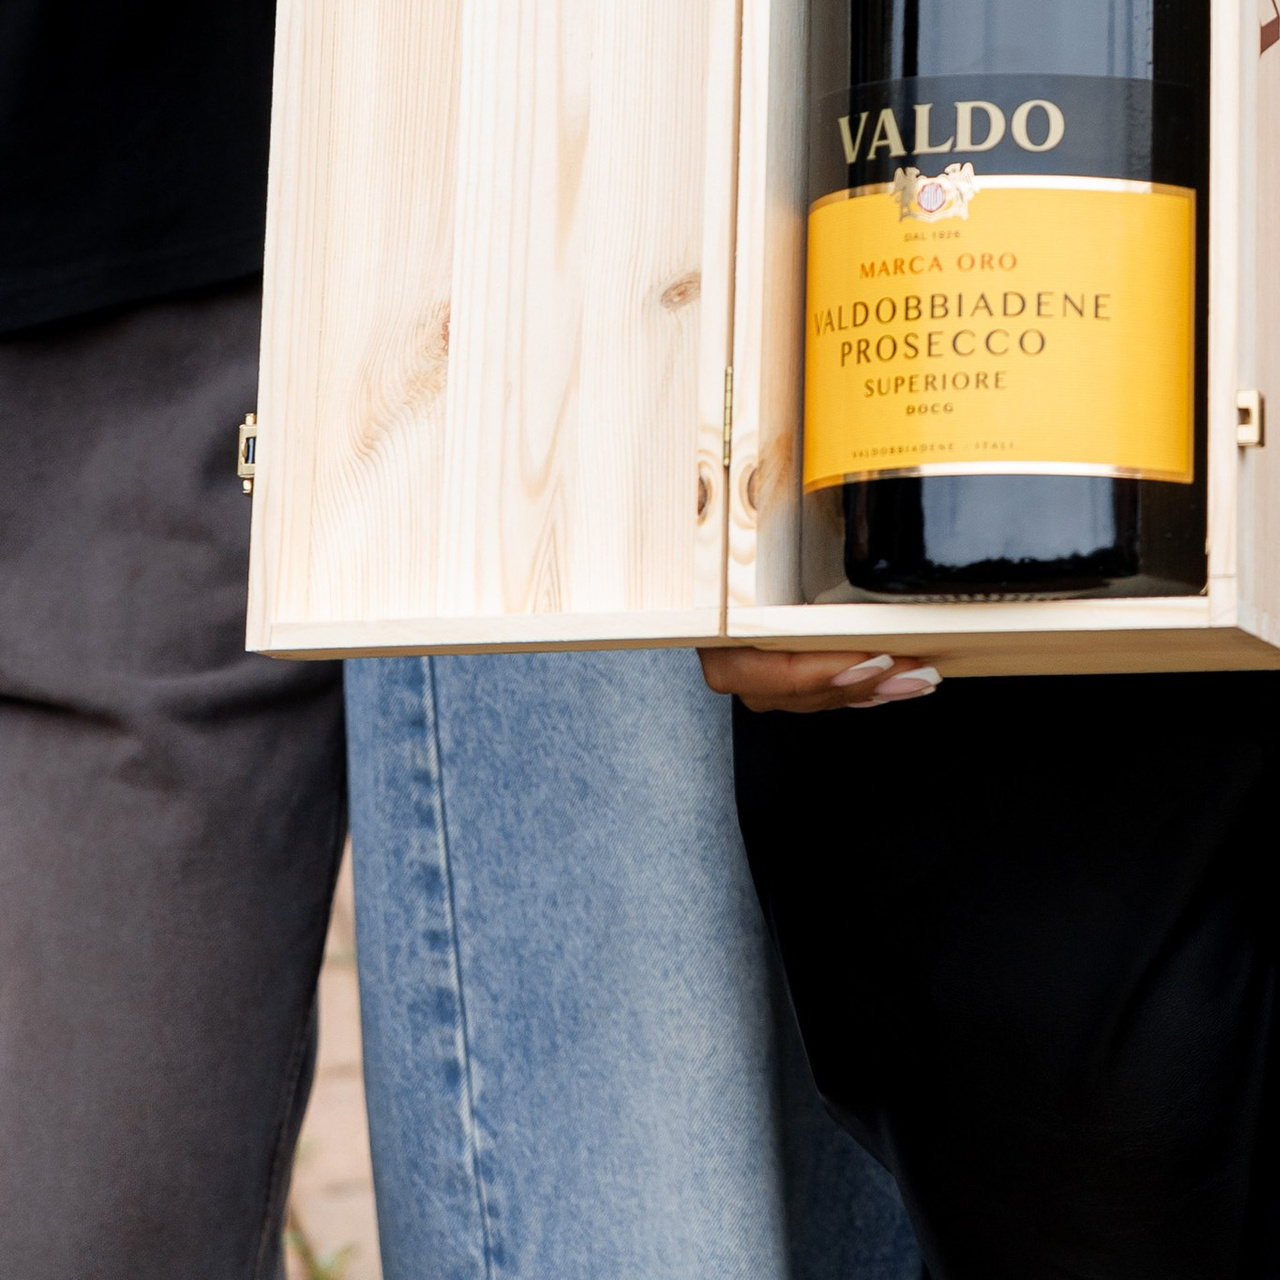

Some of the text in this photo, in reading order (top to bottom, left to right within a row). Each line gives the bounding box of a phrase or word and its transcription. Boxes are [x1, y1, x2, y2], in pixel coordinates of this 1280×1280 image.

[836, 98, 1066, 166] VALDO
[859, 251, 1018, 280] MARCA ORO
[812, 290, 1112, 337] VALDOBBIADENE
[840, 328, 1047, 367] PROSECCO
[863, 370, 1009, 398] SUPERIORE
[905, 402, 955, 416] DOCG
